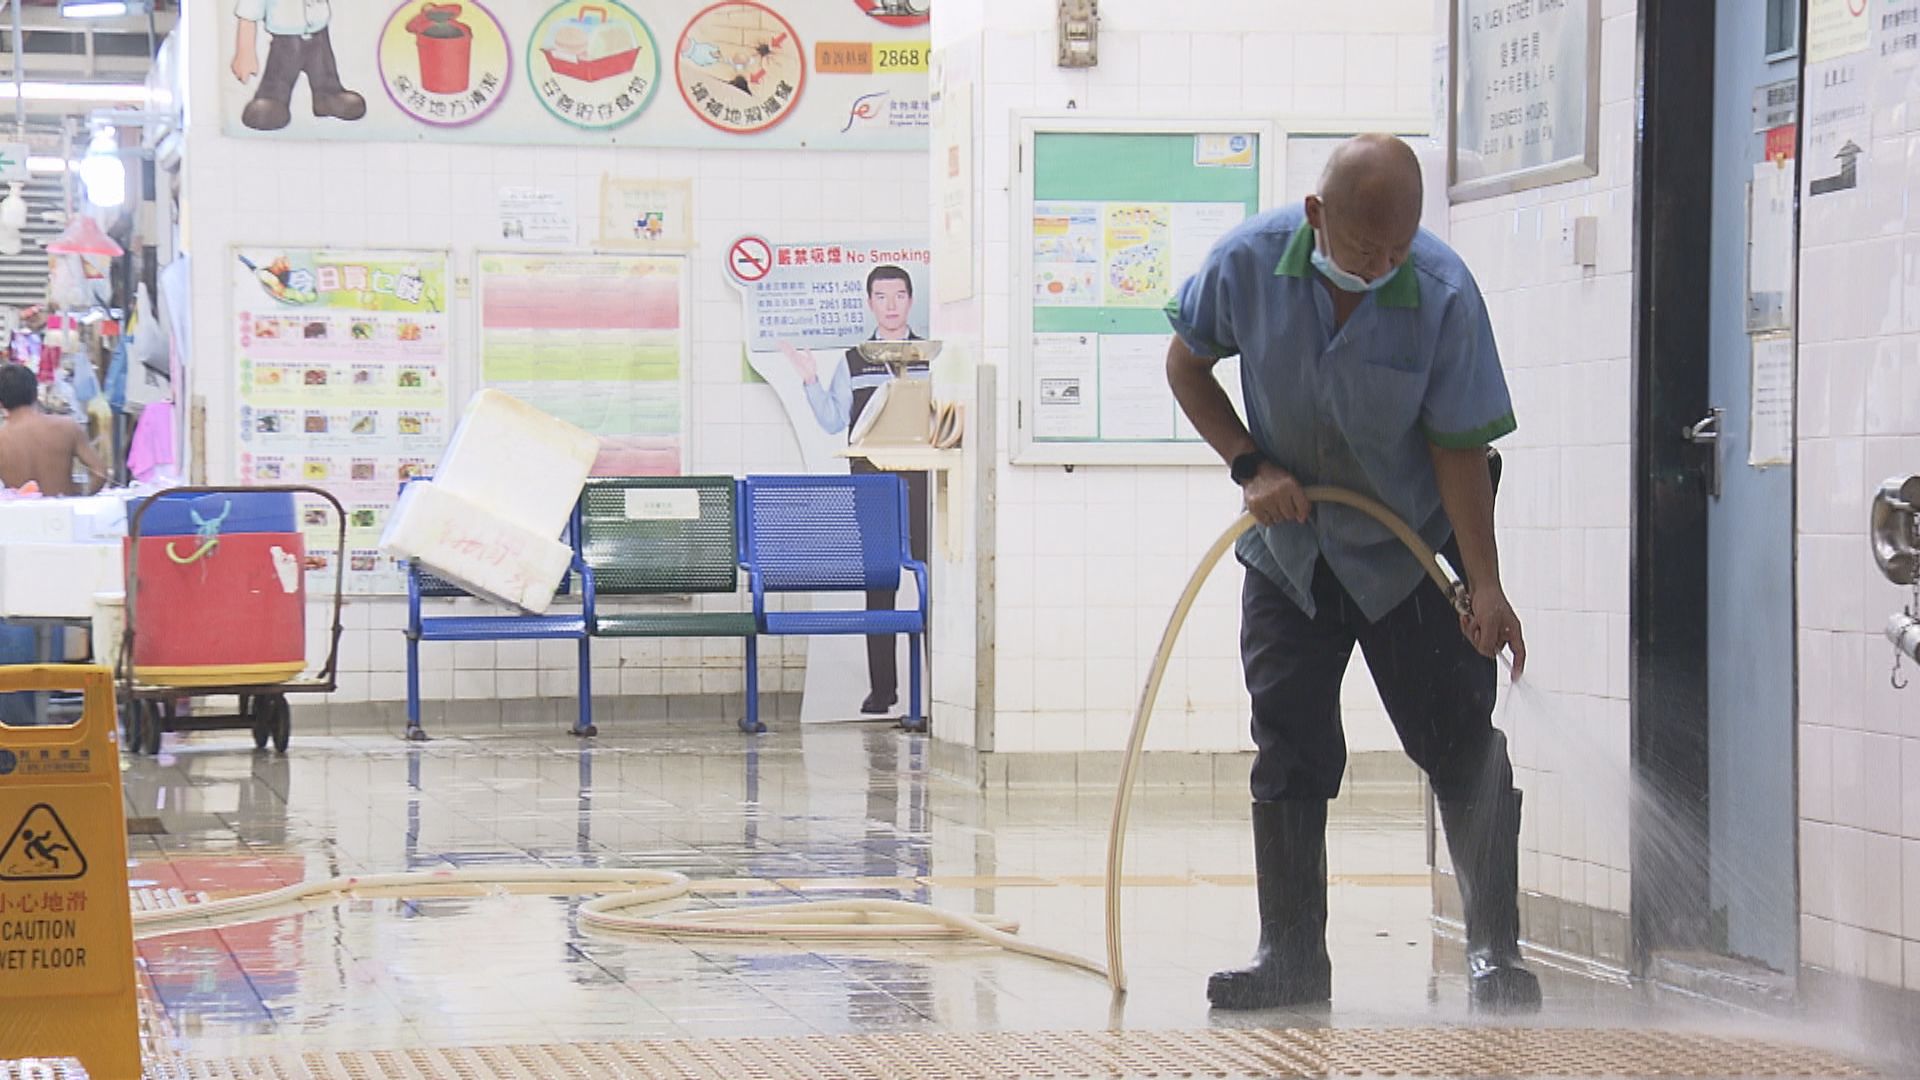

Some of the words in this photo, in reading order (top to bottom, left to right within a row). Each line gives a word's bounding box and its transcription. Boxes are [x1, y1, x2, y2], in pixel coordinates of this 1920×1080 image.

[879, 49, 920, 67] 2868
[1490, 107, 1522, 130] BUSINESS
[777, 247, 841, 266] 嚴禁吸煙
[847, 250, 865, 264] No
[871, 248, 931, 265] Smoking
[815, 312, 840, 324] 1833
[844, 311, 864, 323] 183
[2, 920, 76, 941] CAUTION
[31, 947, 87, 969] FLOOR
